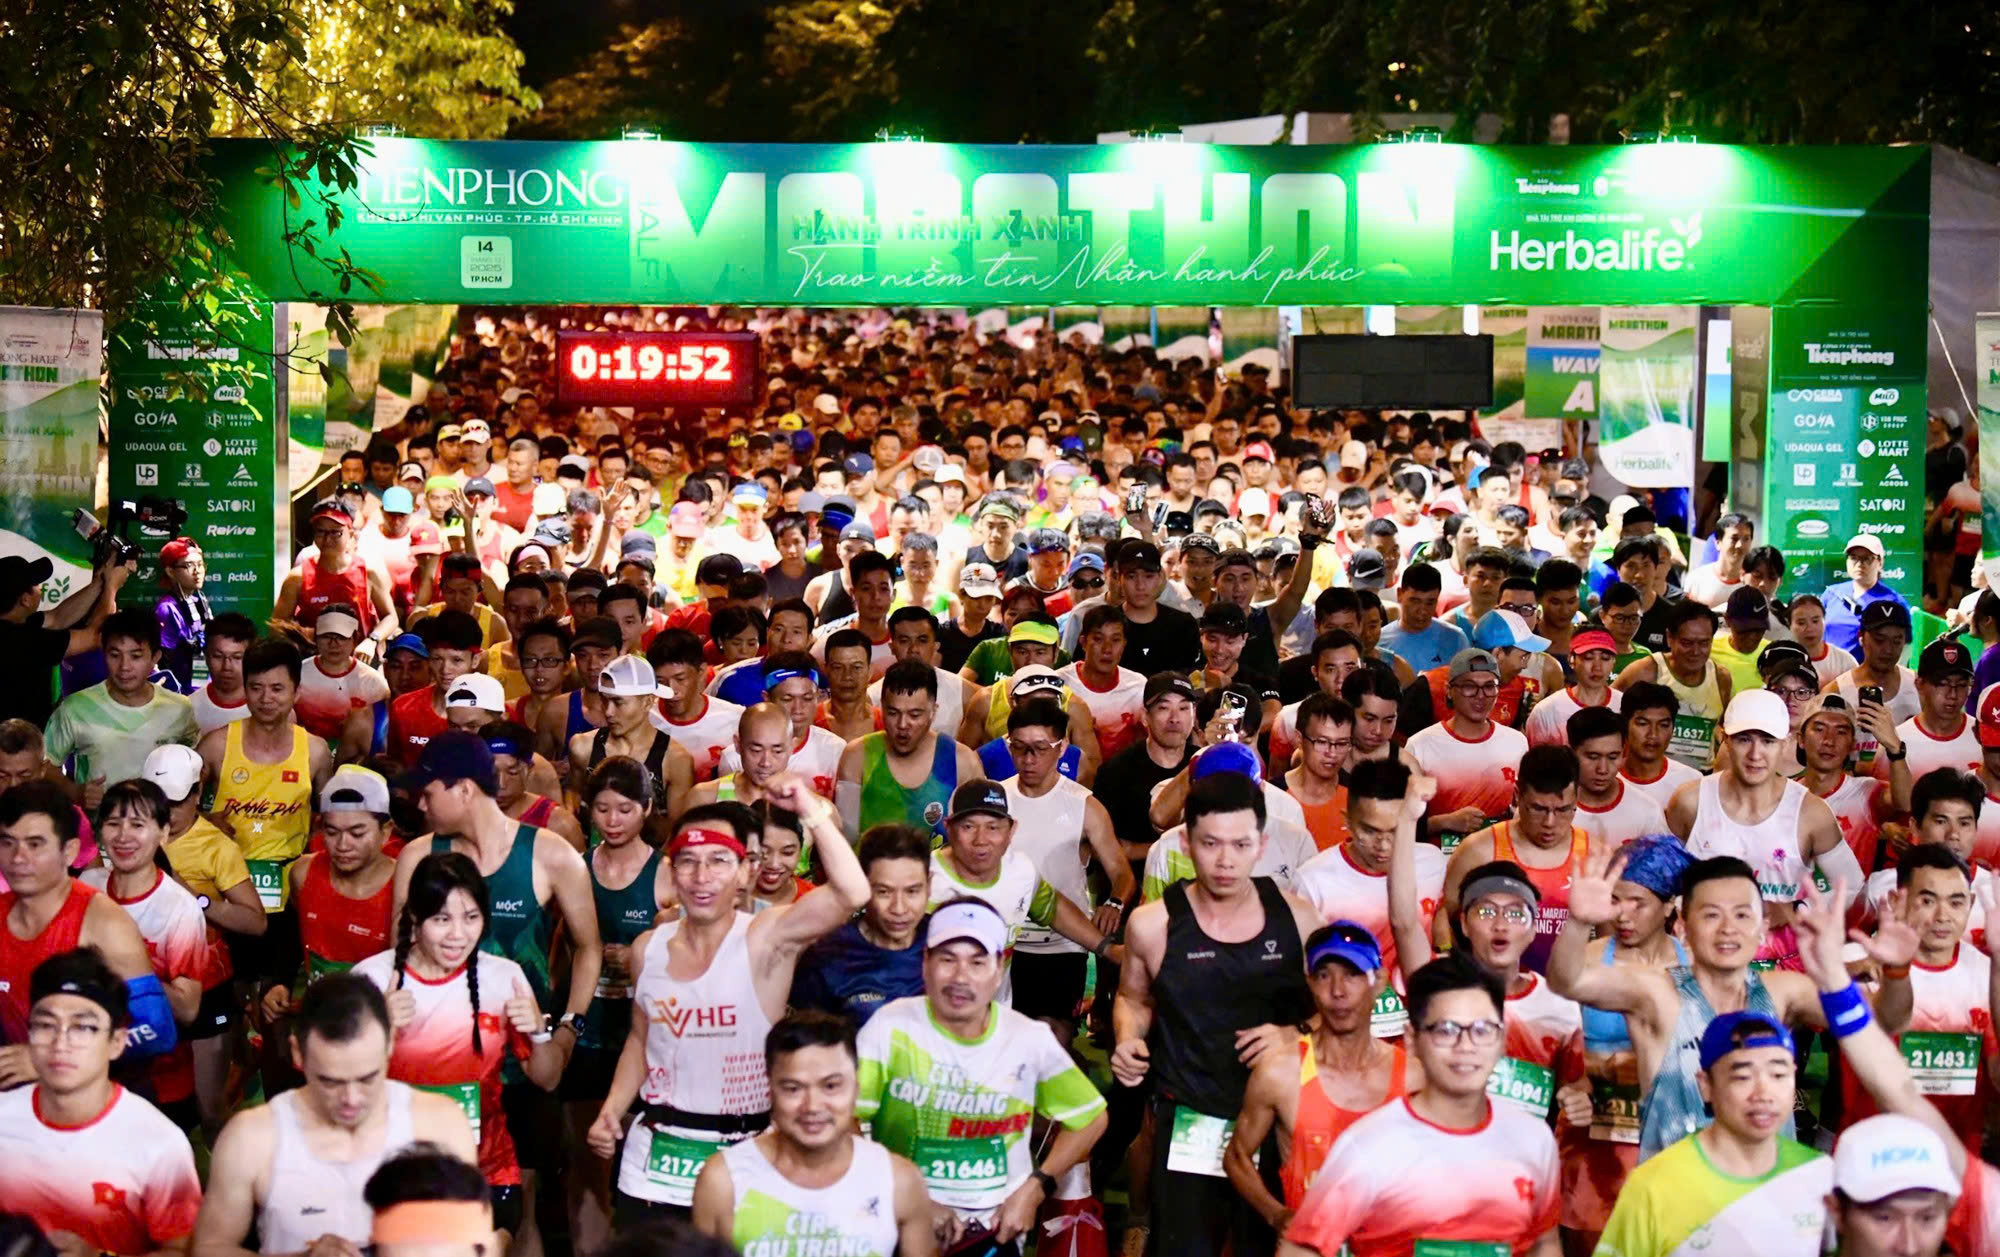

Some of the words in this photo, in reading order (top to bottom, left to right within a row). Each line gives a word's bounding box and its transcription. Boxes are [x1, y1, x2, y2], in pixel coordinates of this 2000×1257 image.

[630, 172, 1456, 290] MARATHON
[477, 241, 494, 252] 14
[1490, 229, 1686, 272] Herbalife
[1608, 320, 1669, 330] MARATHON
[571, 345, 732, 380] 0:19:52
[1552, 356, 1600, 373] WAV
[169, 443, 188, 451] GEL
[225, 439, 258, 447] LOTTE
[1879, 440, 1908, 448] LOTTE
[225, 447, 258, 456] MART
[1879, 448, 1909, 457] MART
[207, 499, 256, 512] SATORI
[1859, 499, 1906, 511] SATORI
[1911, 1049, 1965, 1068] 21483
[931, 1158, 996, 1180] 21646
